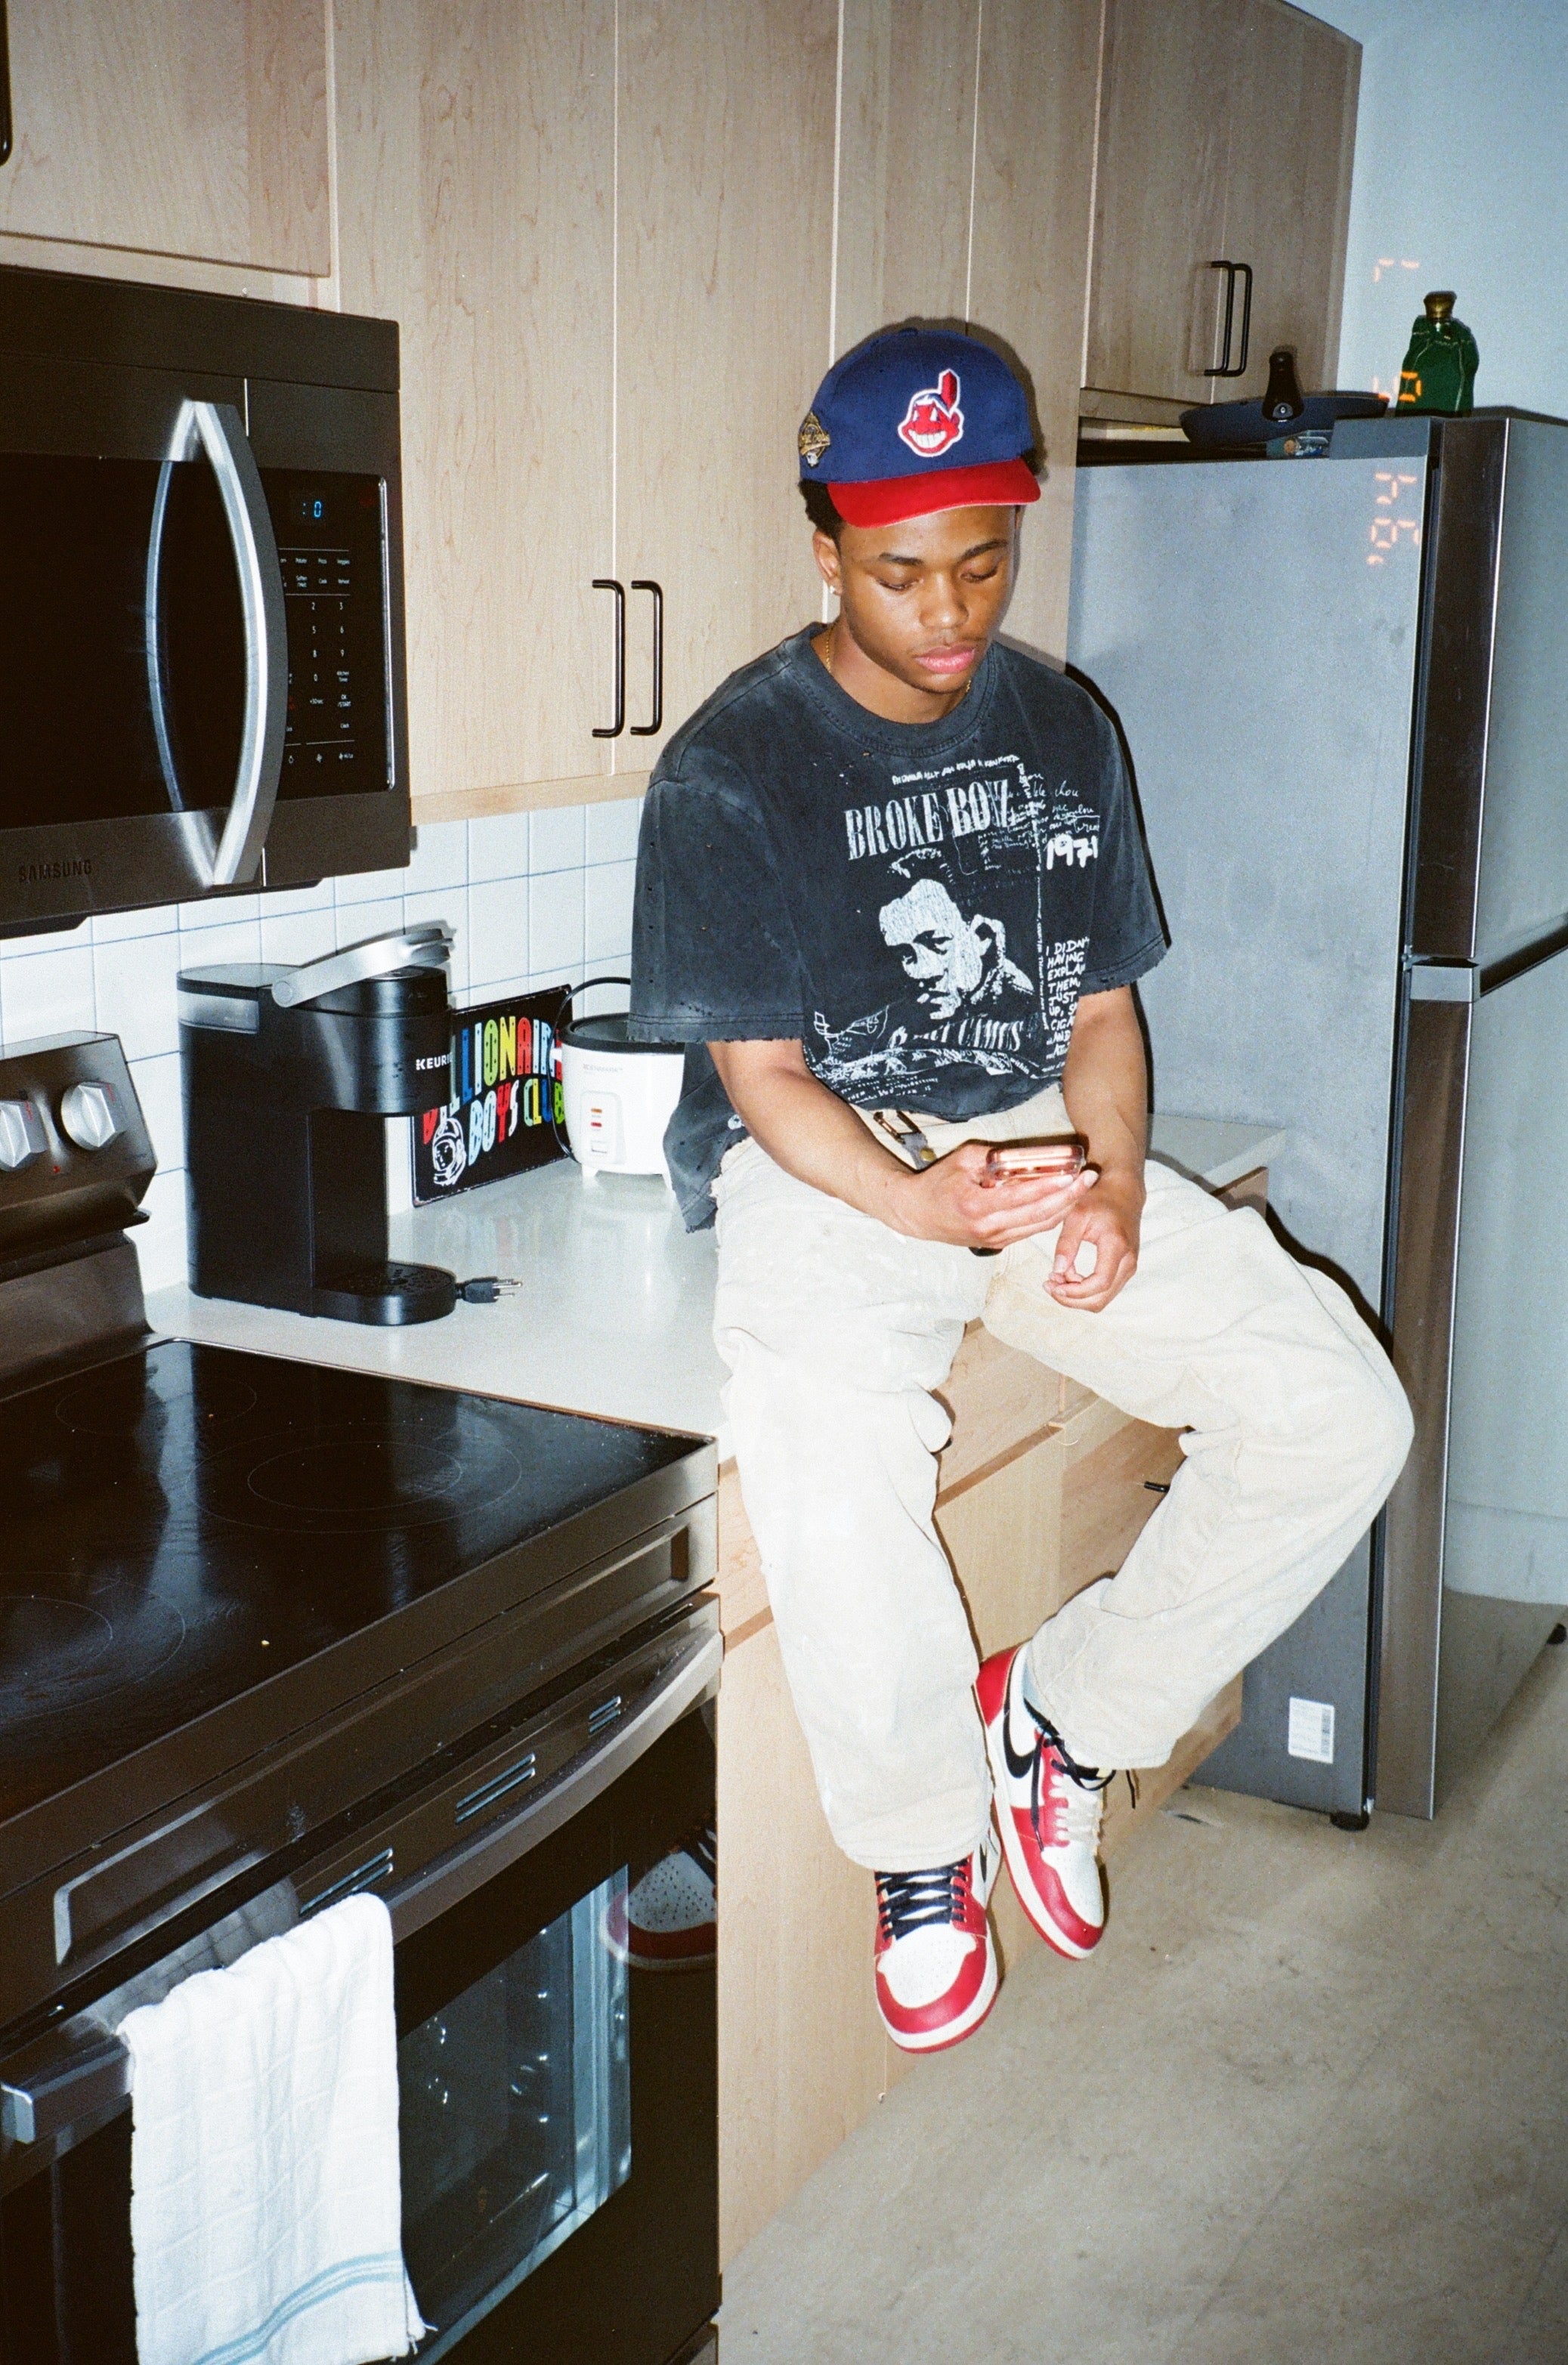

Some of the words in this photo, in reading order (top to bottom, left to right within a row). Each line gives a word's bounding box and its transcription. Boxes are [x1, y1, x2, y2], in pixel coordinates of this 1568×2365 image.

[844, 793, 944, 861] BROKE
[1047, 835, 1098, 870] 1971
[18, 859, 92, 883] SAMSUNG
[1048, 991, 1078, 1006] JUST
[469, 1079, 519, 1166] BOYS
[523, 1078, 565, 1127] CLUB
